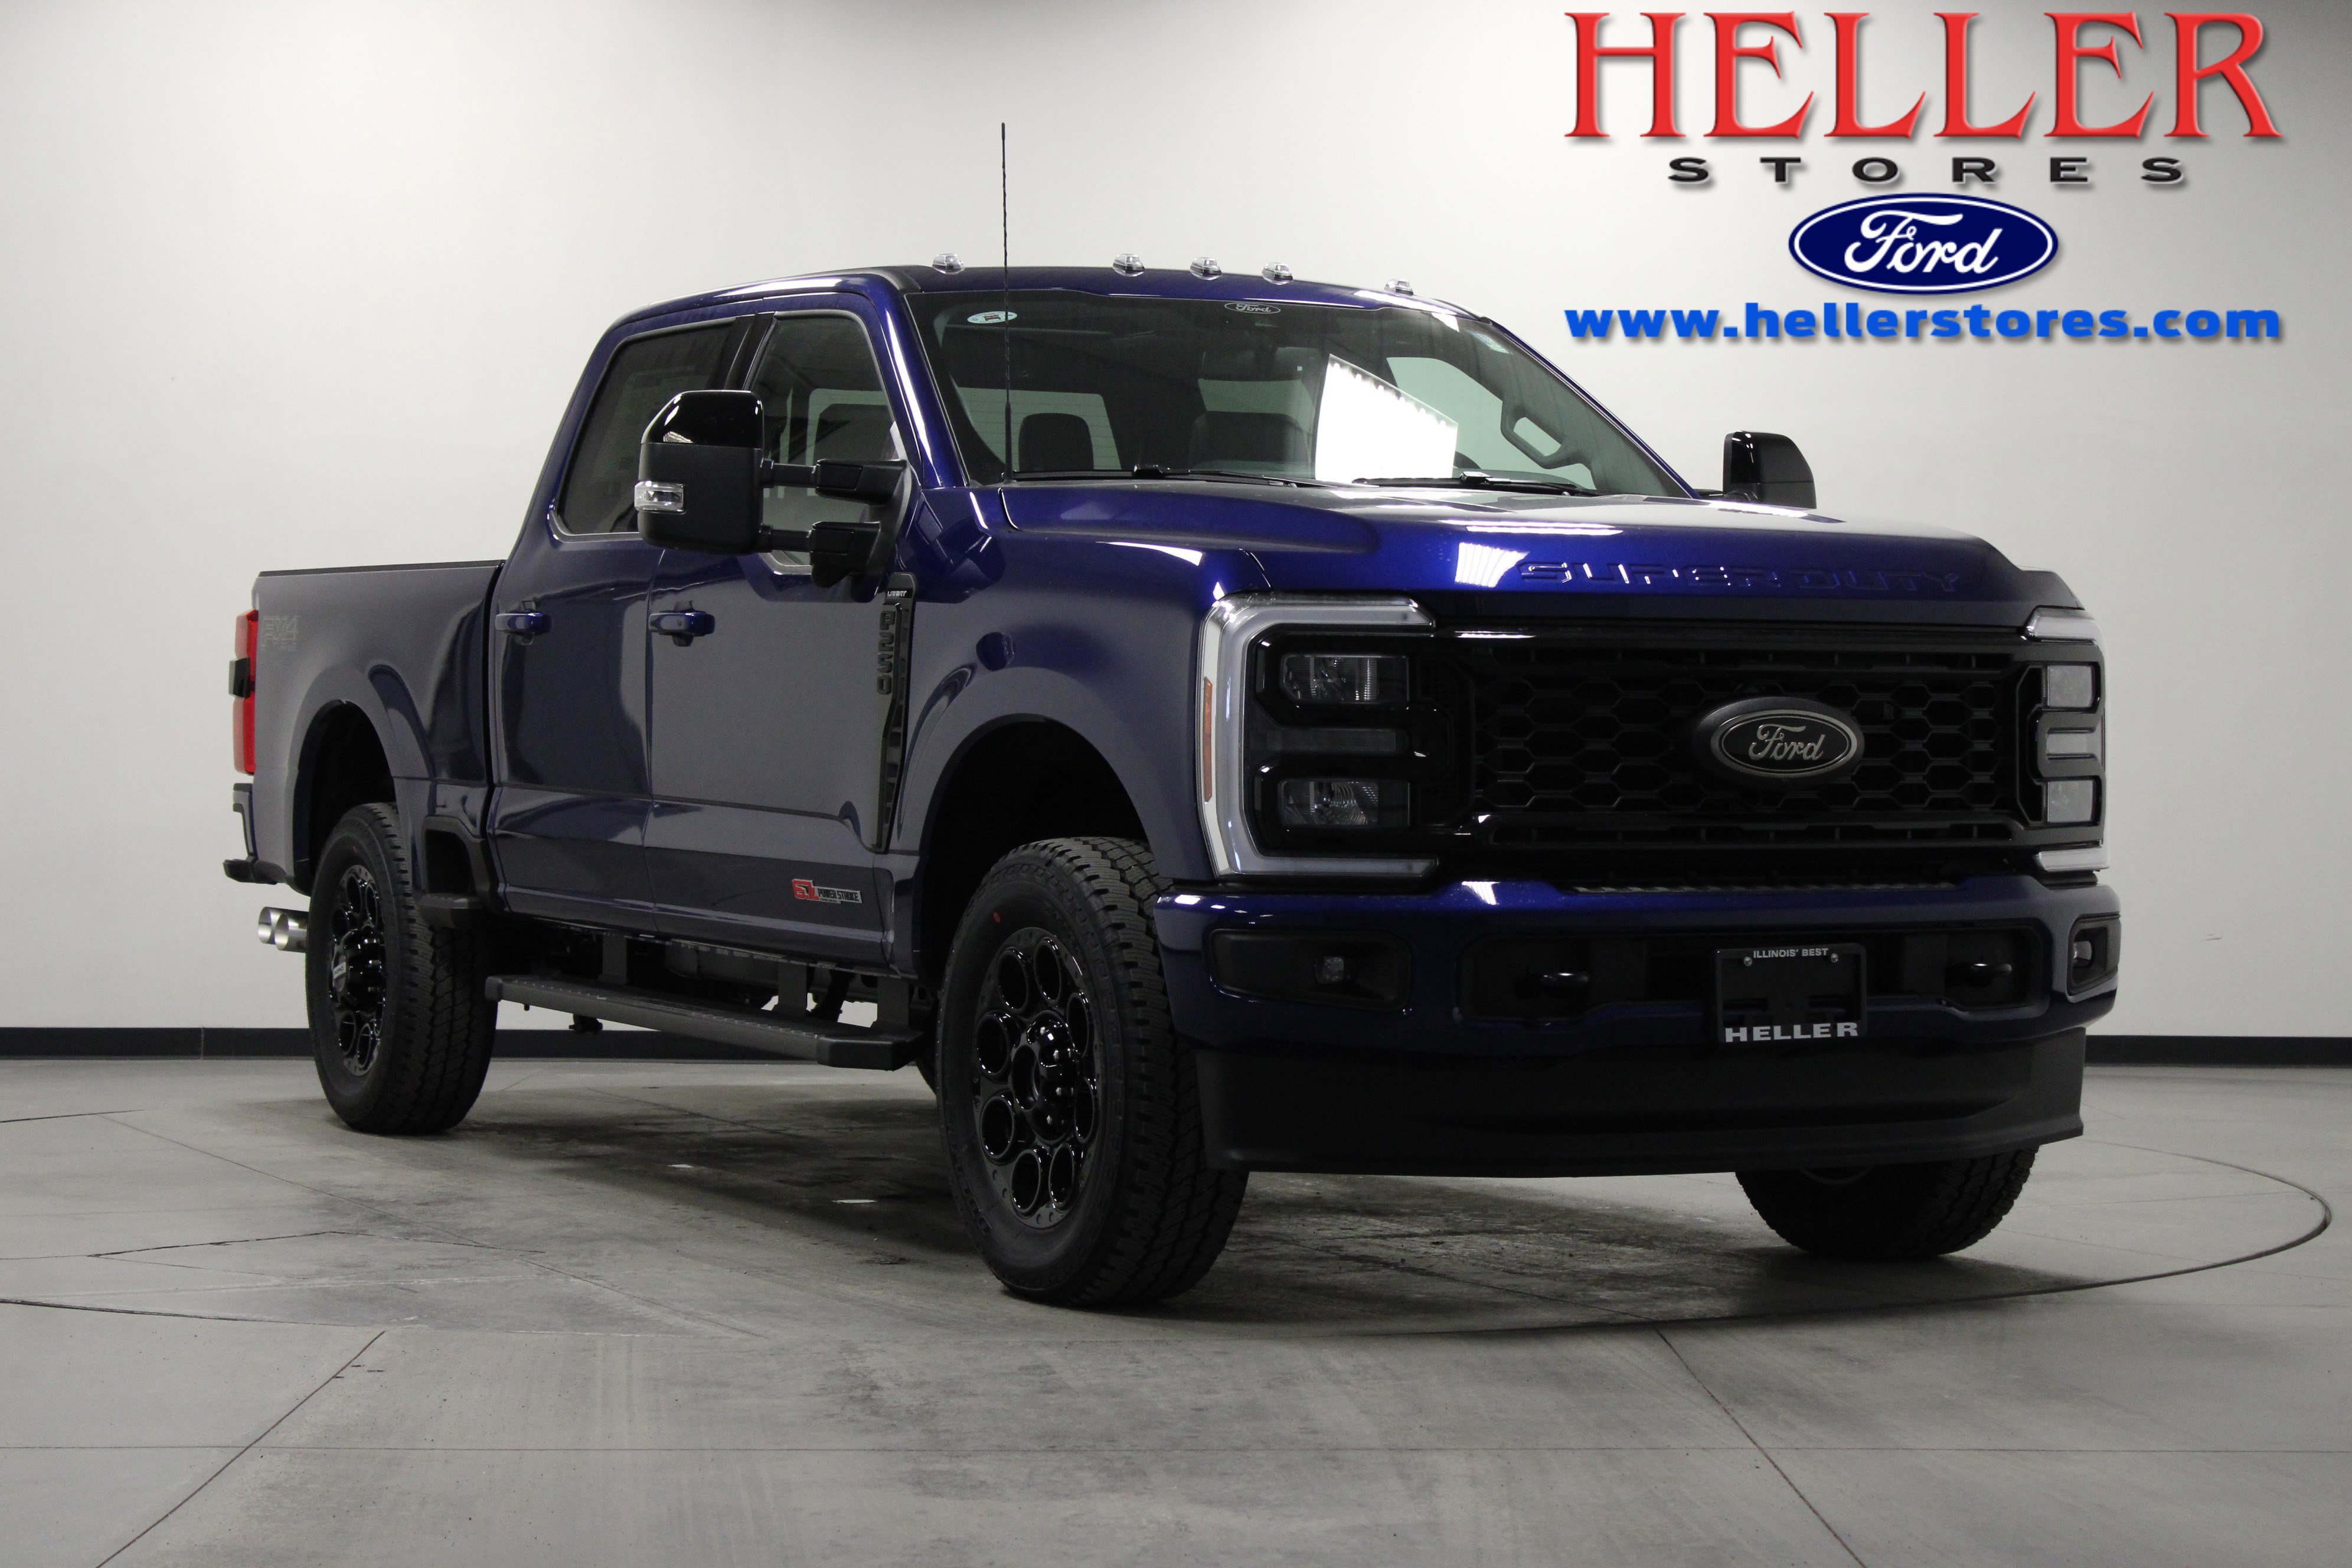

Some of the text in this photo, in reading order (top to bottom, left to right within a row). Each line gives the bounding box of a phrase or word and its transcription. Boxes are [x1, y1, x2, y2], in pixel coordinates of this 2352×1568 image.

[1235, 303, 1272, 312] Ford
[1517, 561, 1959, 592] SUPER DUTY
[1748, 723, 1825, 760] Ford
[1801, 948, 1829, 956] BEST
[1725, 1022, 1858, 1043] HELLER
